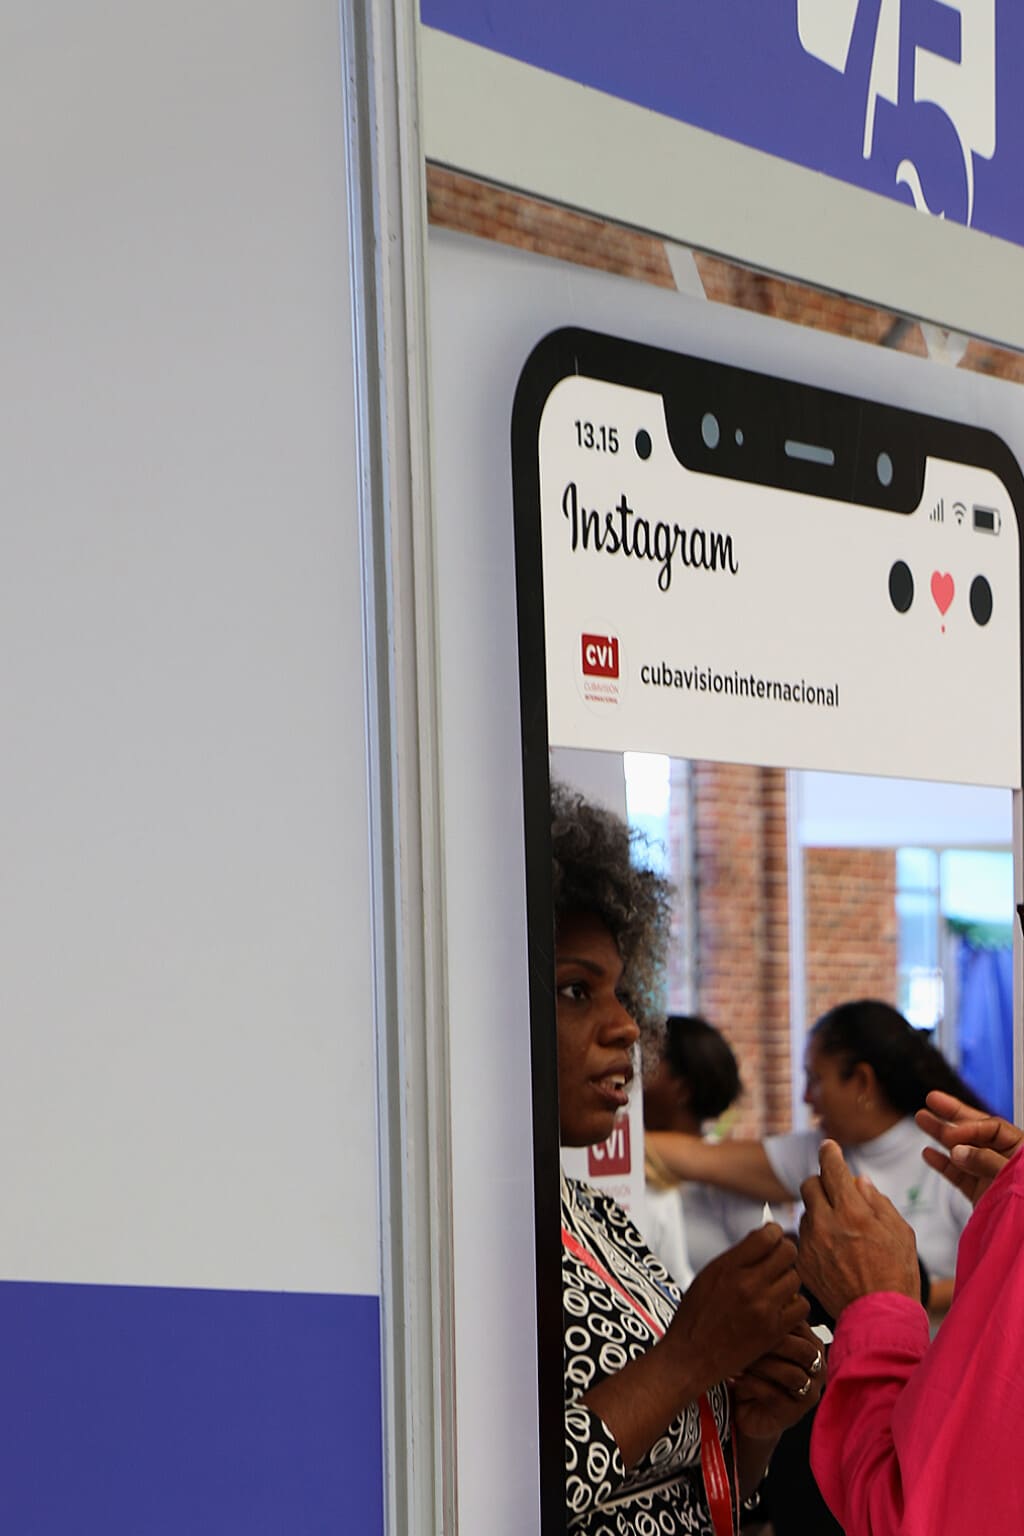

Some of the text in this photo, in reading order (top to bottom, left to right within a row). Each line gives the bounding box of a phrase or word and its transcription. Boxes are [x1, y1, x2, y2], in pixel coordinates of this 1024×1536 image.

[574, 420, 620, 454] 13.15
[562, 482, 739, 591] Instagram
[641, 662, 840, 707] cubavisioninternacional
